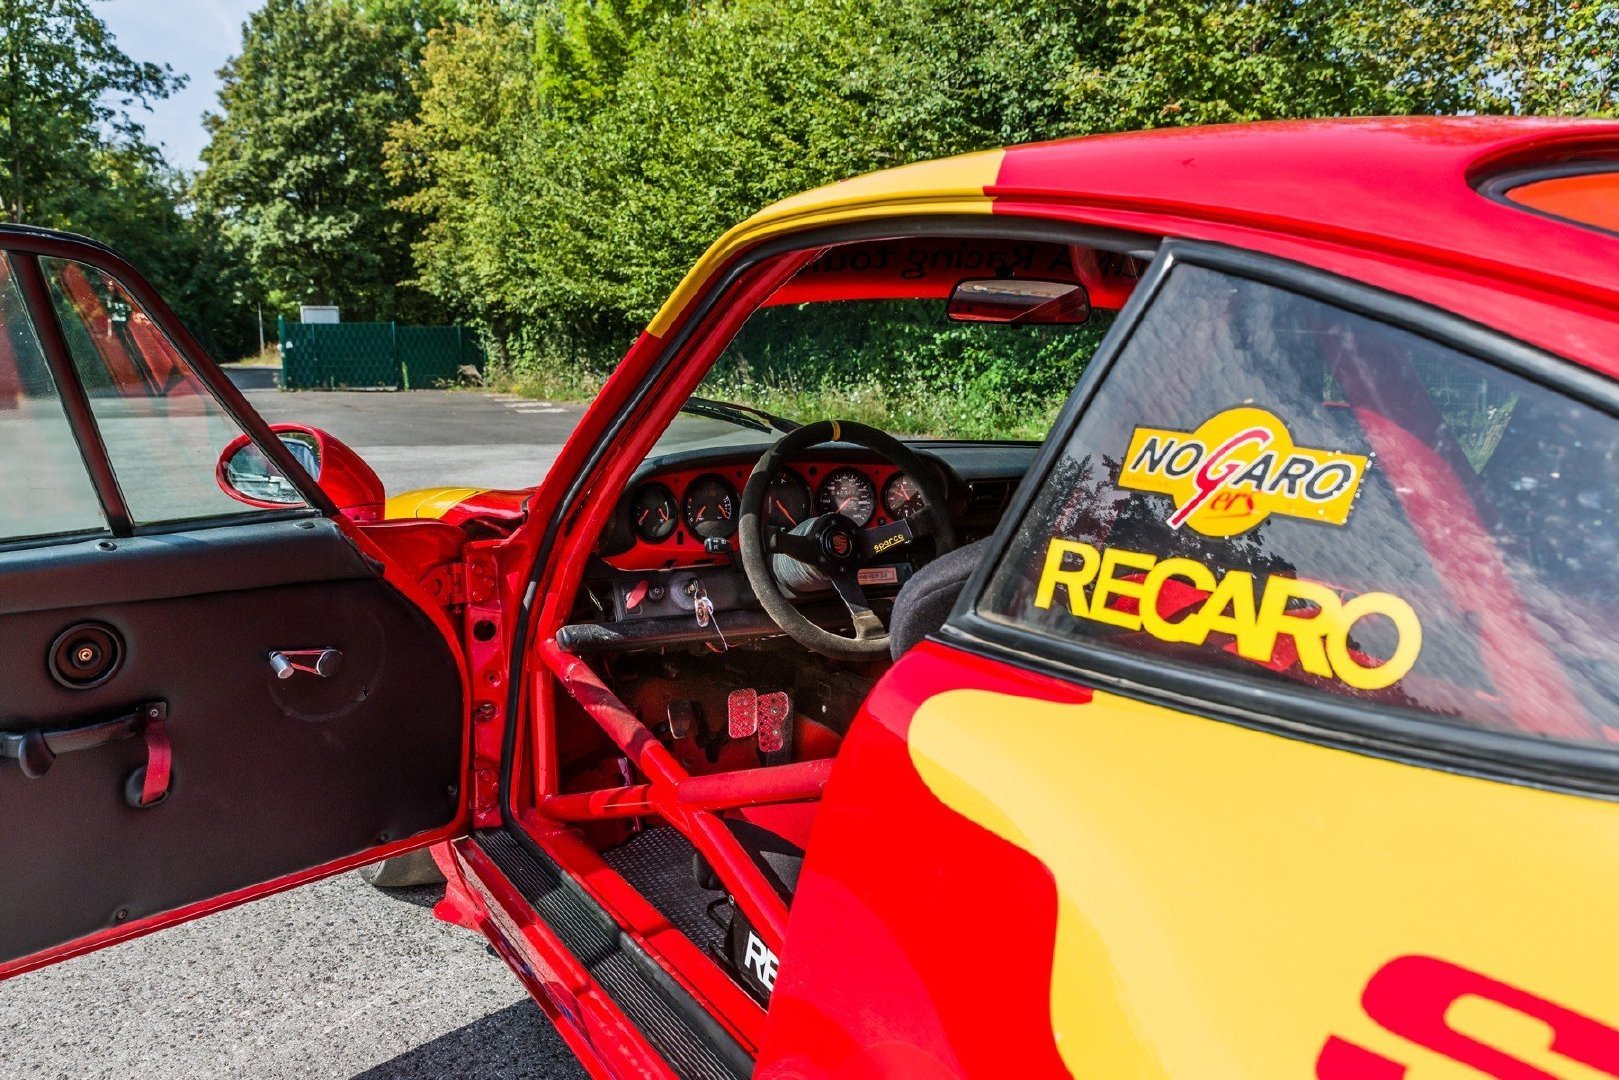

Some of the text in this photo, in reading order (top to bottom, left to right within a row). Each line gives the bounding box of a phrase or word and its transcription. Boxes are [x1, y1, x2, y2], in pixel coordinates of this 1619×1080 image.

[1130, 428, 1357, 530] NOGARO
[873, 533, 905, 553] sparco
[1033, 537, 1422, 690] RECARO
